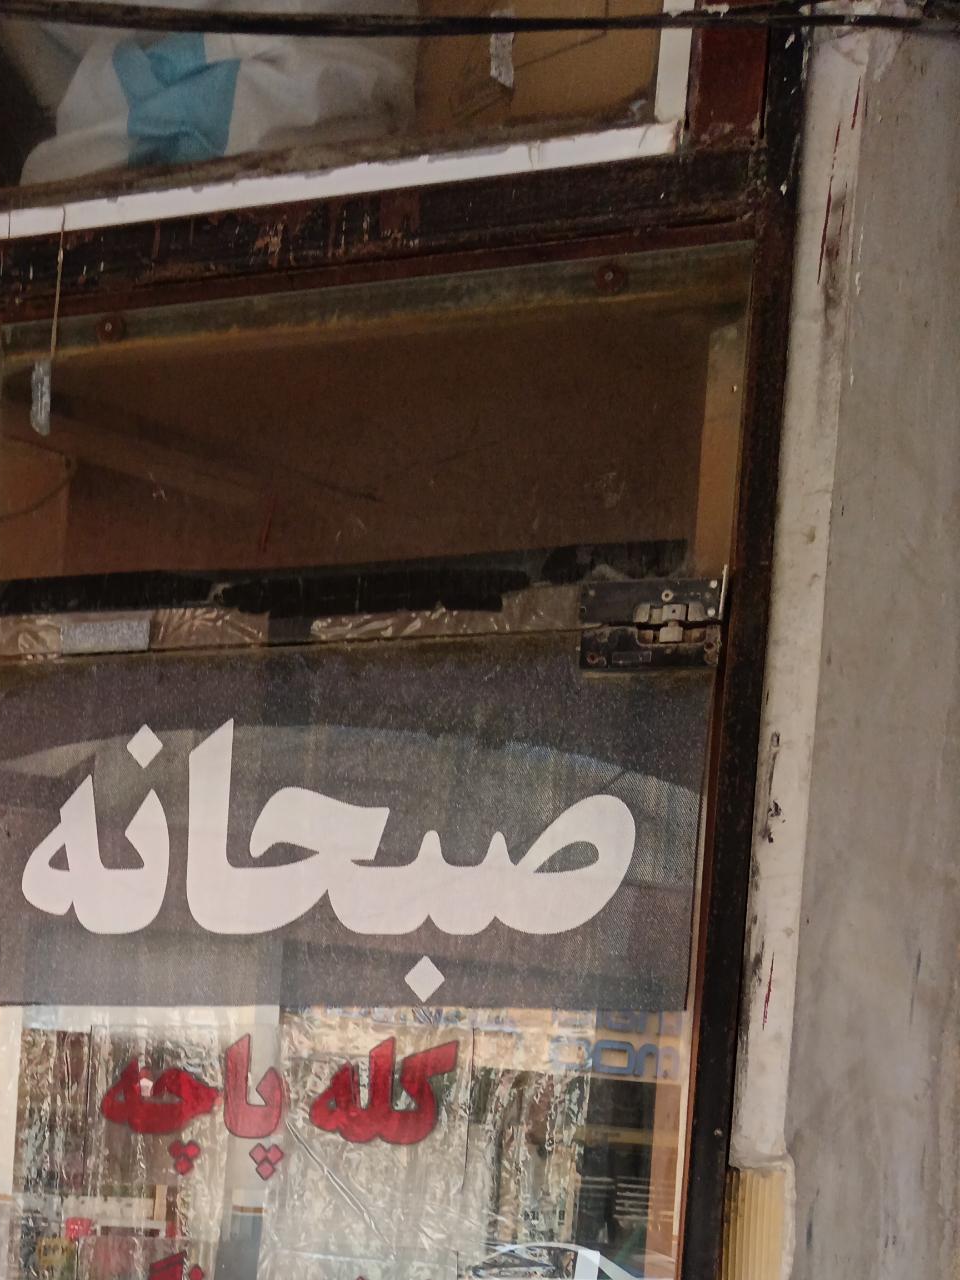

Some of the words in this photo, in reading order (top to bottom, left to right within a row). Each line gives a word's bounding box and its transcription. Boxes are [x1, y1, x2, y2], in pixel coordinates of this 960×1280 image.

[21, 716, 636, 1002] صبحانه
[100, 1032, 287, 1181] پاچه
[306, 1035, 459, 1146] کله
